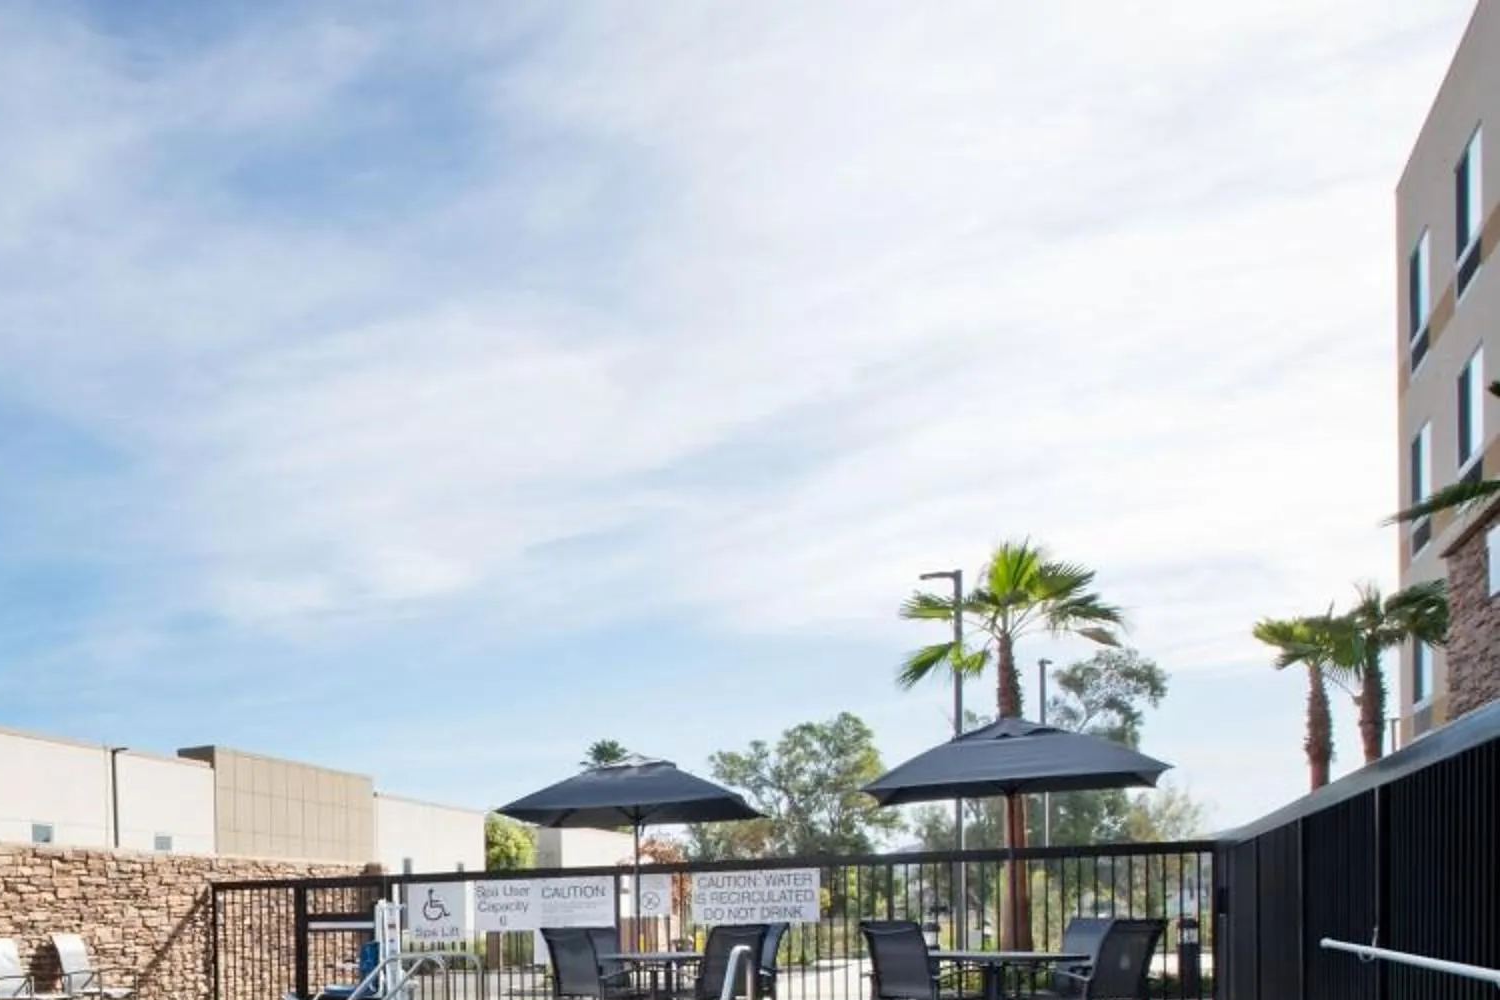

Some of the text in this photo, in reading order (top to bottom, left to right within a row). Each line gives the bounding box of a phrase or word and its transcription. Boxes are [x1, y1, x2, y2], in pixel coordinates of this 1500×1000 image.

[764, 871, 812, 888] WATER
[475, 884, 531, 900] Spa User
[541, 884, 606, 899] CAUTION
[477, 902, 529, 914] Capacity
[703, 905, 804, 921] DO NOT DRINK
